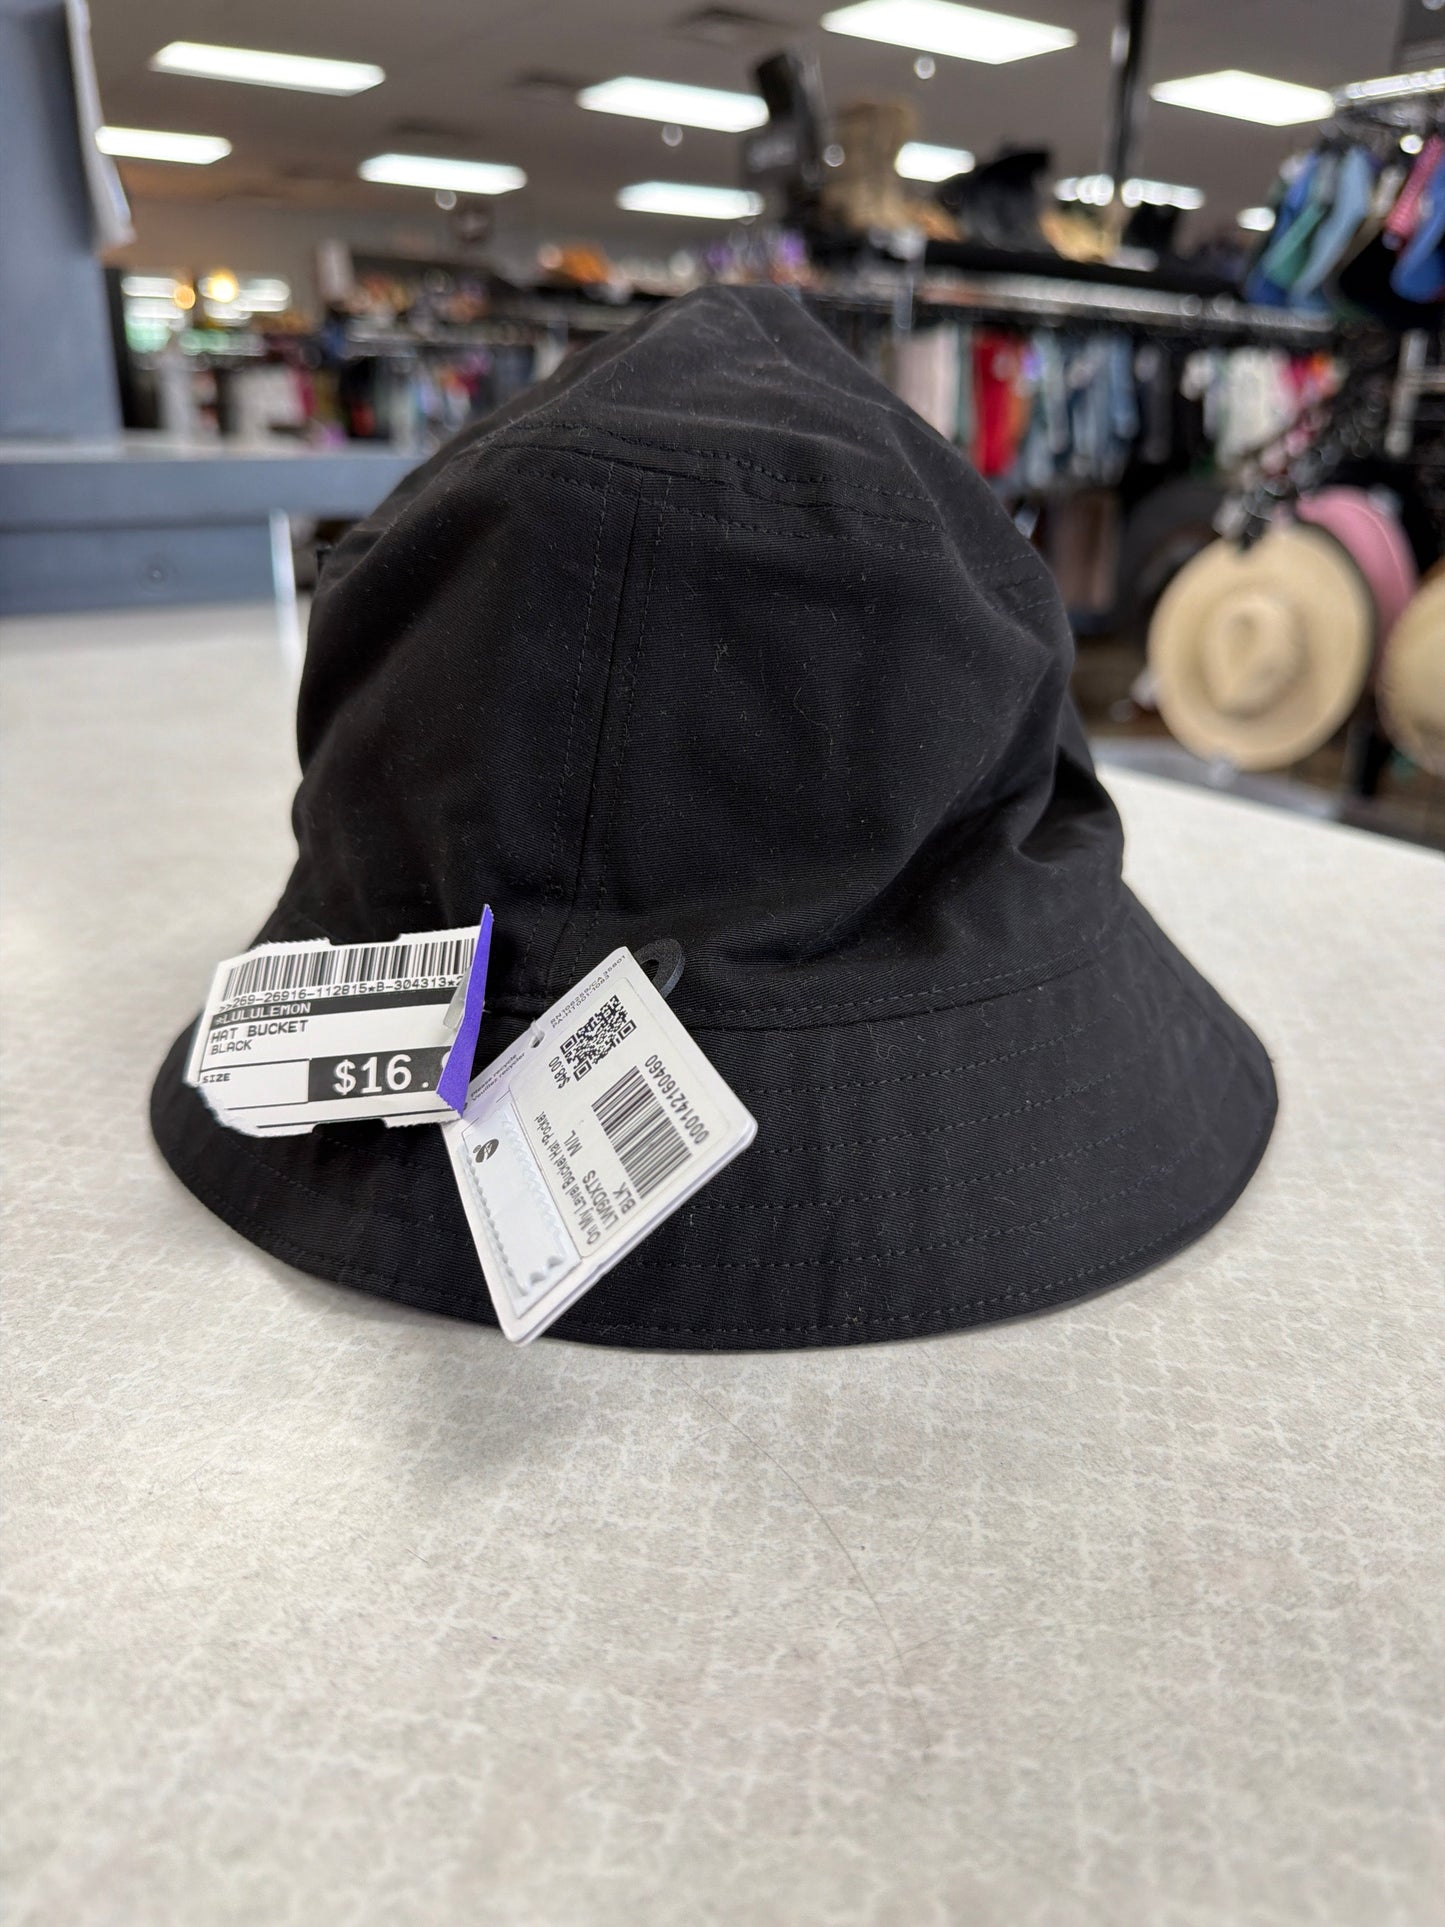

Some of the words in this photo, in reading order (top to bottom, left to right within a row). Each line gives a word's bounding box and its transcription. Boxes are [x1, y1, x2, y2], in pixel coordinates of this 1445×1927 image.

[211, 1027, 239, 1044] HAT
[247, 1019, 309, 1038] BUCKET
[210, 1039, 252, 1056] BLACK
[202, 1071, 231, 1084] SIZE
[333, 1052, 451, 1096] $16.
[549, 1056, 570, 1089] $48.00
[644, 1054, 710, 1145] 000142160460
[547, 1139, 562, 1161] Hat
[563, 1129, 583, 1157] M/L
[553, 1154, 576, 1190] Bucket
[565, 1183, 587, 1214] Level
[582, 1169, 619, 1230] LW9DXTS
[612, 1181, 636, 1214] BLK
[578, 1206, 595, 1231] My
[586, 1223, 601, 1245] On
